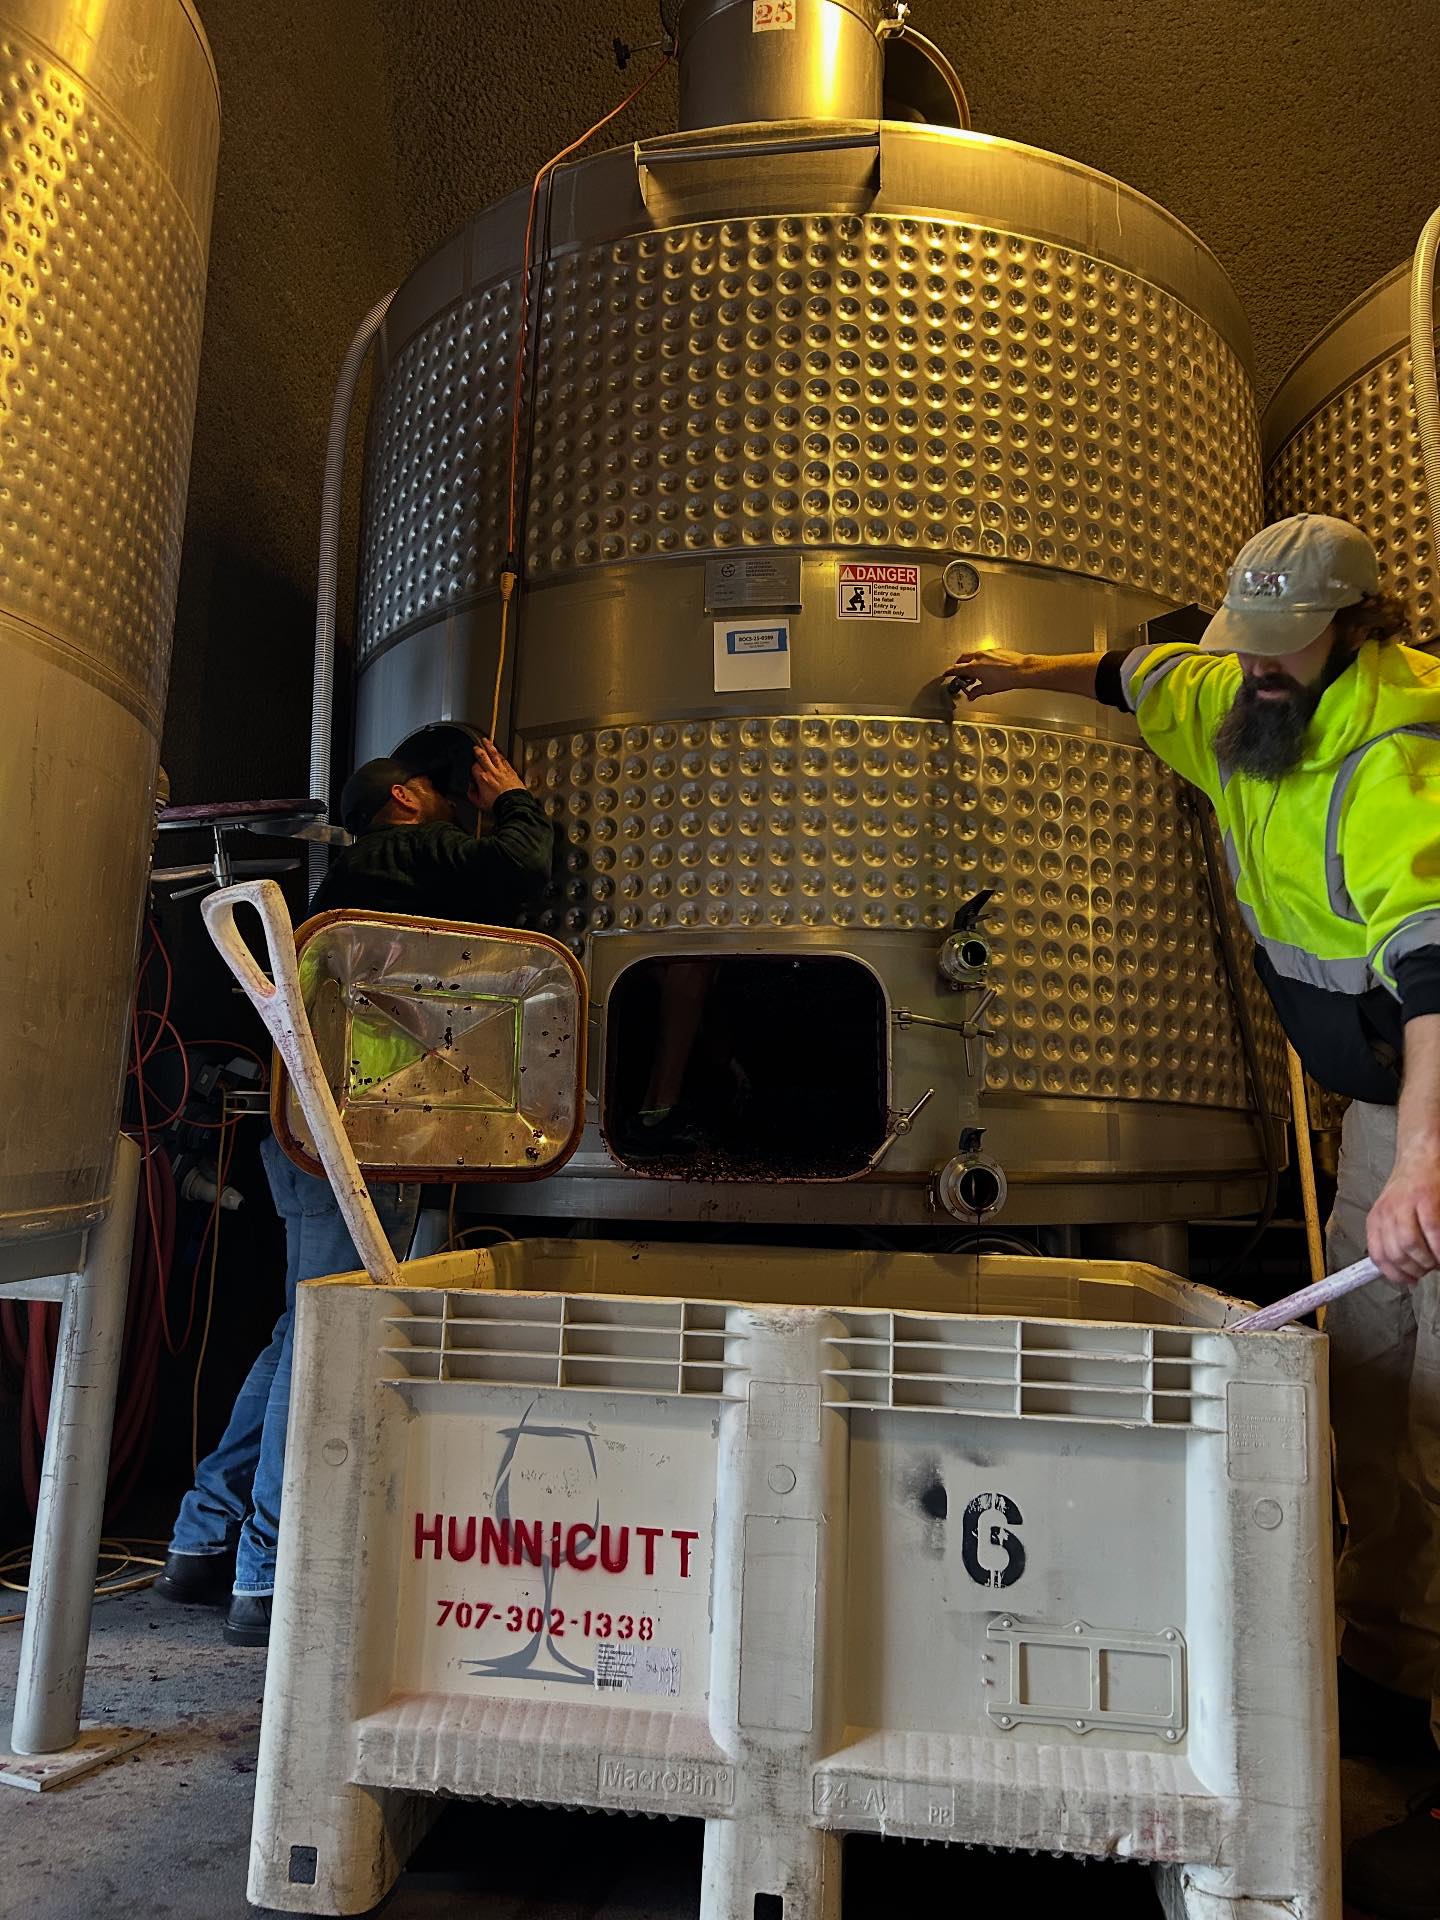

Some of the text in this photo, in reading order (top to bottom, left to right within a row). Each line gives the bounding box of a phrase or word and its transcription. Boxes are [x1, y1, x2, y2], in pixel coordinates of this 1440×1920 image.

[857, 566, 916, 583] DANGER
[414, 1512, 699, 1578] HUNNICUTT
[961, 1492, 1026, 1588] 6
[436, 1600, 654, 1641] 707-302-1338
[928, 1805, 951, 1824] PP
